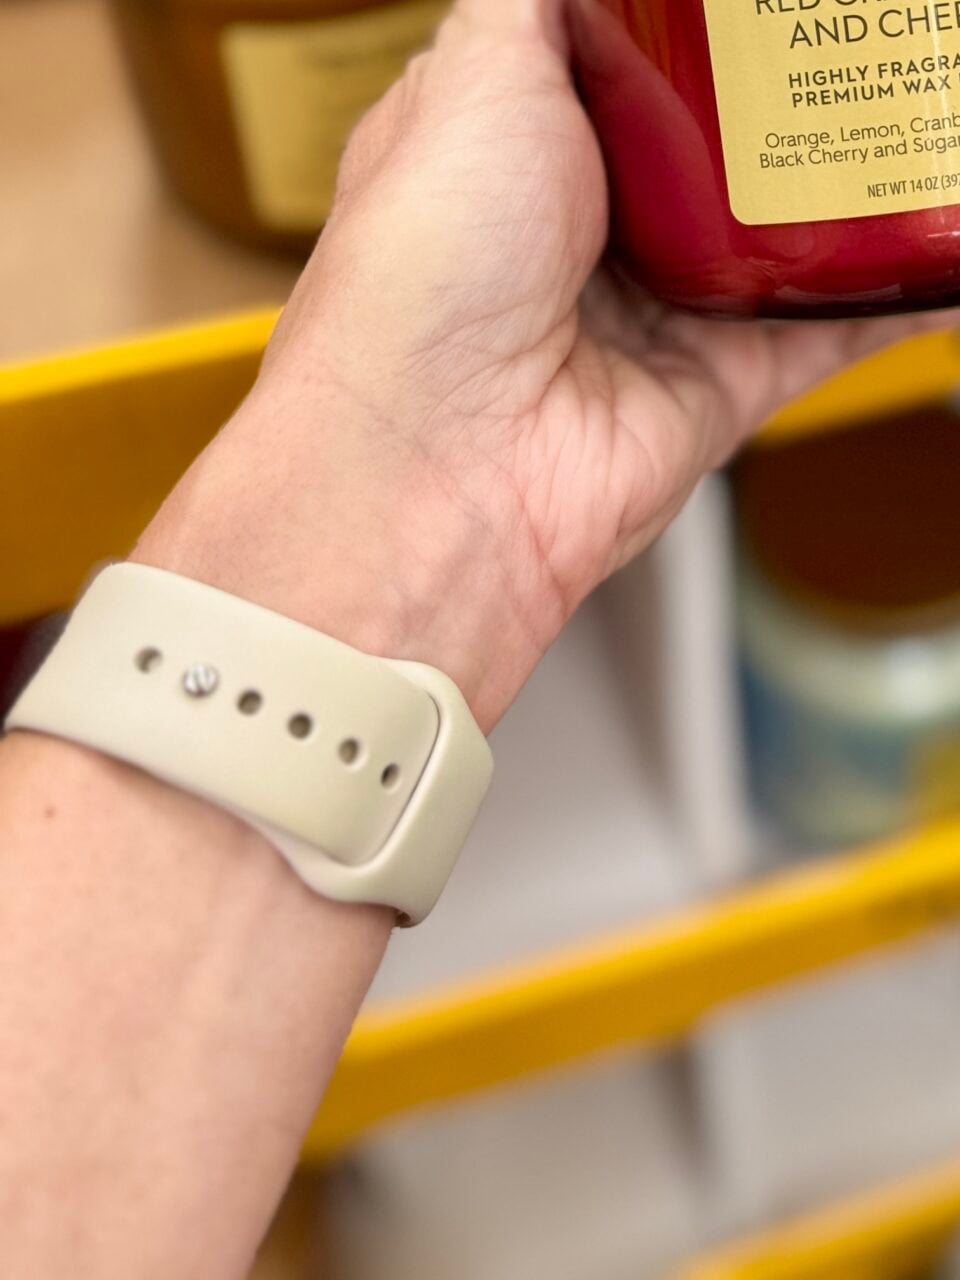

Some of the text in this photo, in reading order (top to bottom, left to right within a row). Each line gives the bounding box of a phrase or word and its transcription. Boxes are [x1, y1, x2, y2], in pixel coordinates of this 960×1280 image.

[789, 14, 868, 49] AND
[788, 65, 869, 88] HIGHLY
[792, 82, 895, 107] PREMIUM
[904, 76, 952, 95] WAX
[765, 130, 834, 150] Orange,
[840, 120, 904, 144] Lemon,
[759, 151, 804, 168] Black
[808, 144, 868, 167] Cherry
[873, 140, 908, 158] and
[867, 184, 888, 198] NET
[889, 180, 908, 195] WT
[910, 179, 923, 192] 14
[924, 176, 939, 190] OZ
